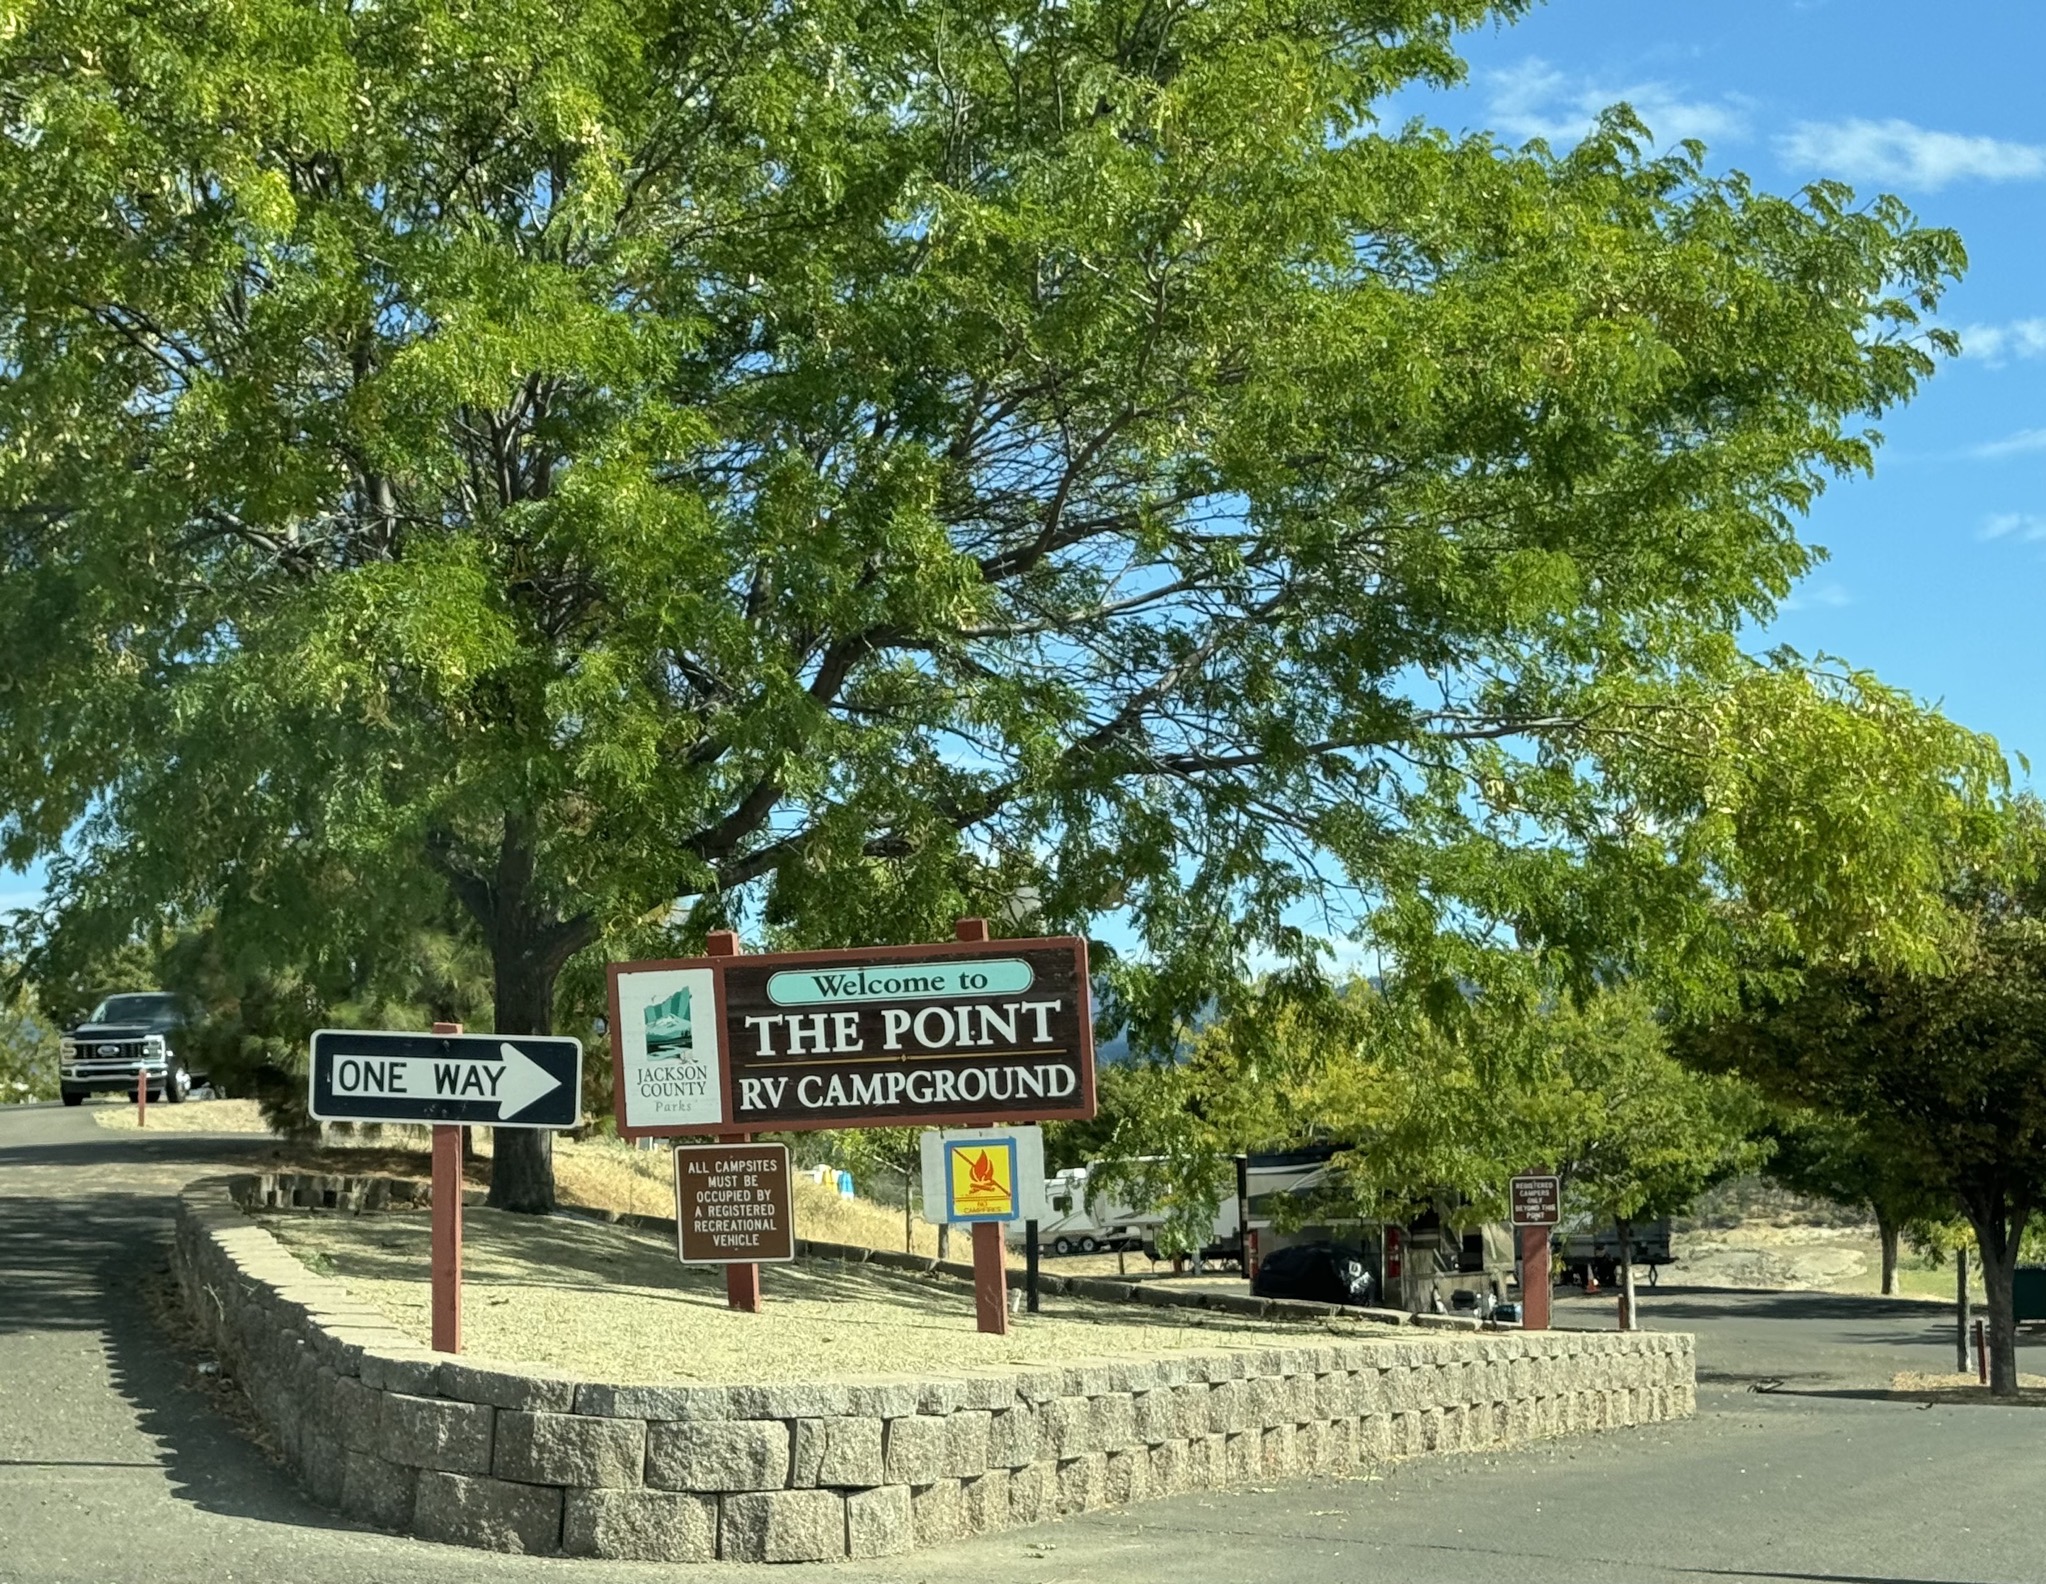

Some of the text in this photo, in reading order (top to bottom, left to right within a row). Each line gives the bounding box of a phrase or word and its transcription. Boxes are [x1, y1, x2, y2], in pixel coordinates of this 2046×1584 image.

[811, 972, 988, 997] Welcome to
[745, 999, 1062, 1056] THE POINT
[339, 1060, 506, 1096] ONE WAY
[637, 1065, 707, 1085] JACKSON
[640, 1081, 706, 1098] COUNTY
[739, 1064, 1076, 1111] RV CAMPGROUND
[655, 1099, 692, 1112] Parks
[688, 1160, 777, 1173] ALL CAMPSITES
[708, 1175, 758, 1187] MUST BE
[697, 1189, 771, 1203] OCCUPIED BY
[695, 1204, 775, 1218] A REGISTERED
[694, 1219, 777, 1232] RECREATIONAL
[713, 1234, 759, 1246] VEHICLE
